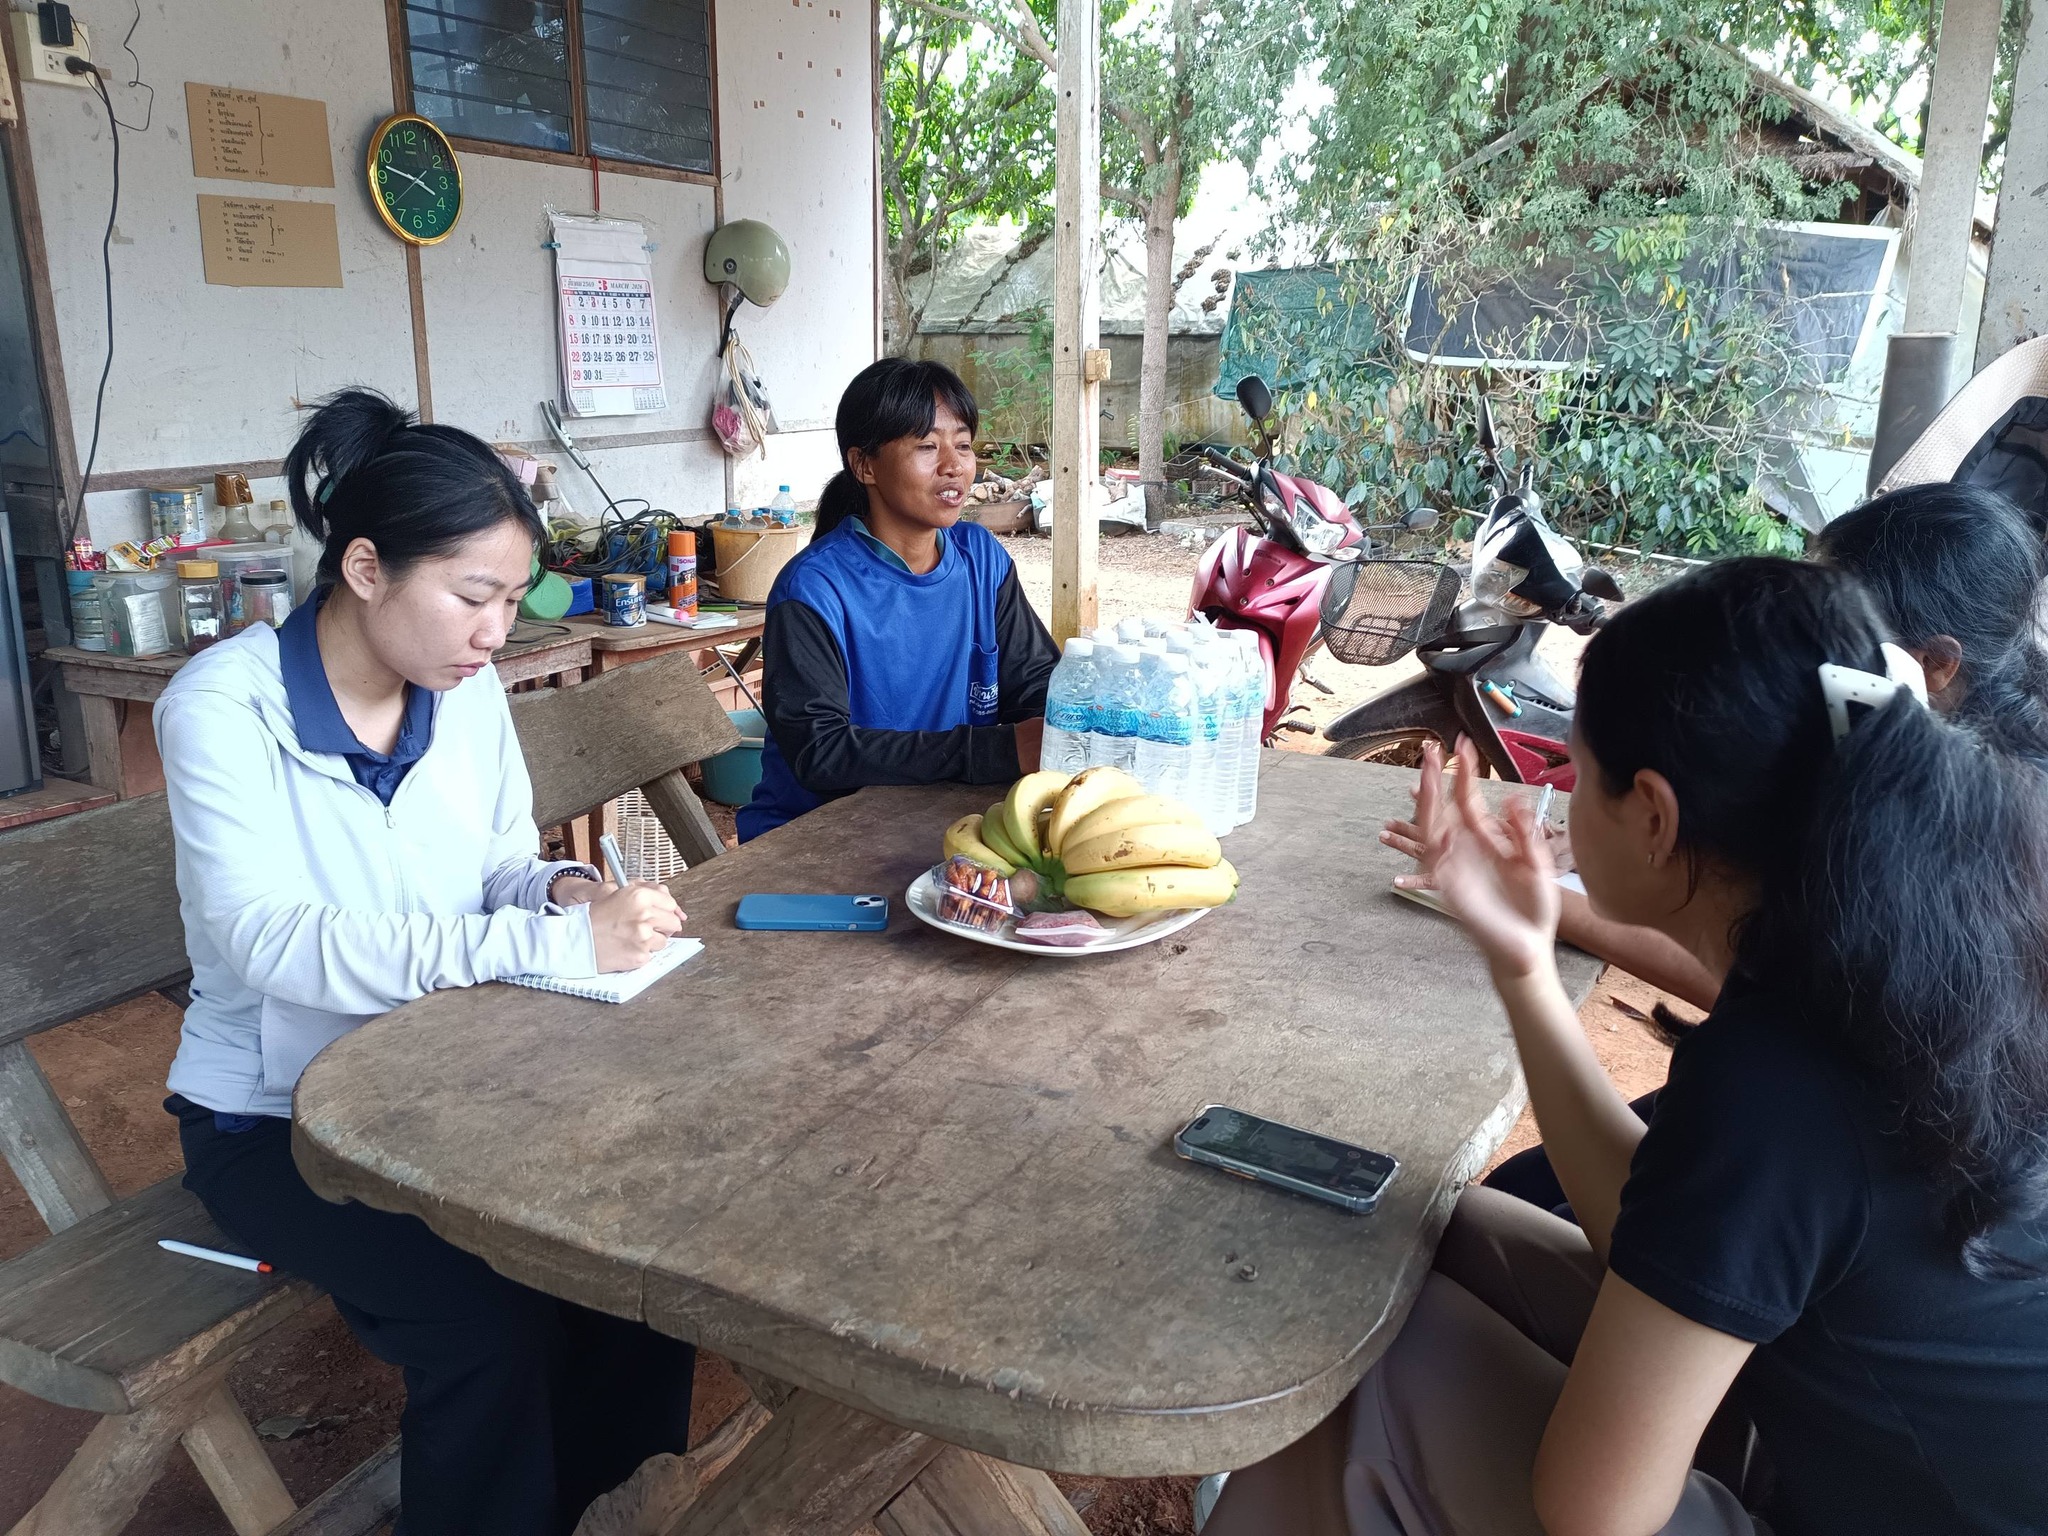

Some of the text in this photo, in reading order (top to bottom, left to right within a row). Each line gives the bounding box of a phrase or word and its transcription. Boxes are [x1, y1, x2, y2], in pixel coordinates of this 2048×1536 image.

[389, 133, 400, 148] 11
[403, 130, 417, 146] 12
[423, 138, 427, 152] 1
[378, 149, 393, 164] 10
[432, 155, 442, 169] 2
[377, 169, 388, 184] 9
[439, 176, 448, 190] 3
[385, 191, 395, 206] 8
[436, 196, 446, 210] 4
[397, 208, 406, 222] 7
[413, 214, 423, 229] 6
[427, 210, 437, 224] 5
[567, 296, 646, 309] 1 2 3 4 5 6 7
[569, 315, 651, 327] 8 9 10 11 12 13 14
[569, 333, 653, 344] 15 16 17 18 19 20 21
[571, 351, 655, 362] 22 23 24 25 26 27 28
[573, 370, 581, 381] 29
[583, 370, 592, 380] 30
[594, 370, 602, 380] 31
[615, 594, 644, 607] Ensure
